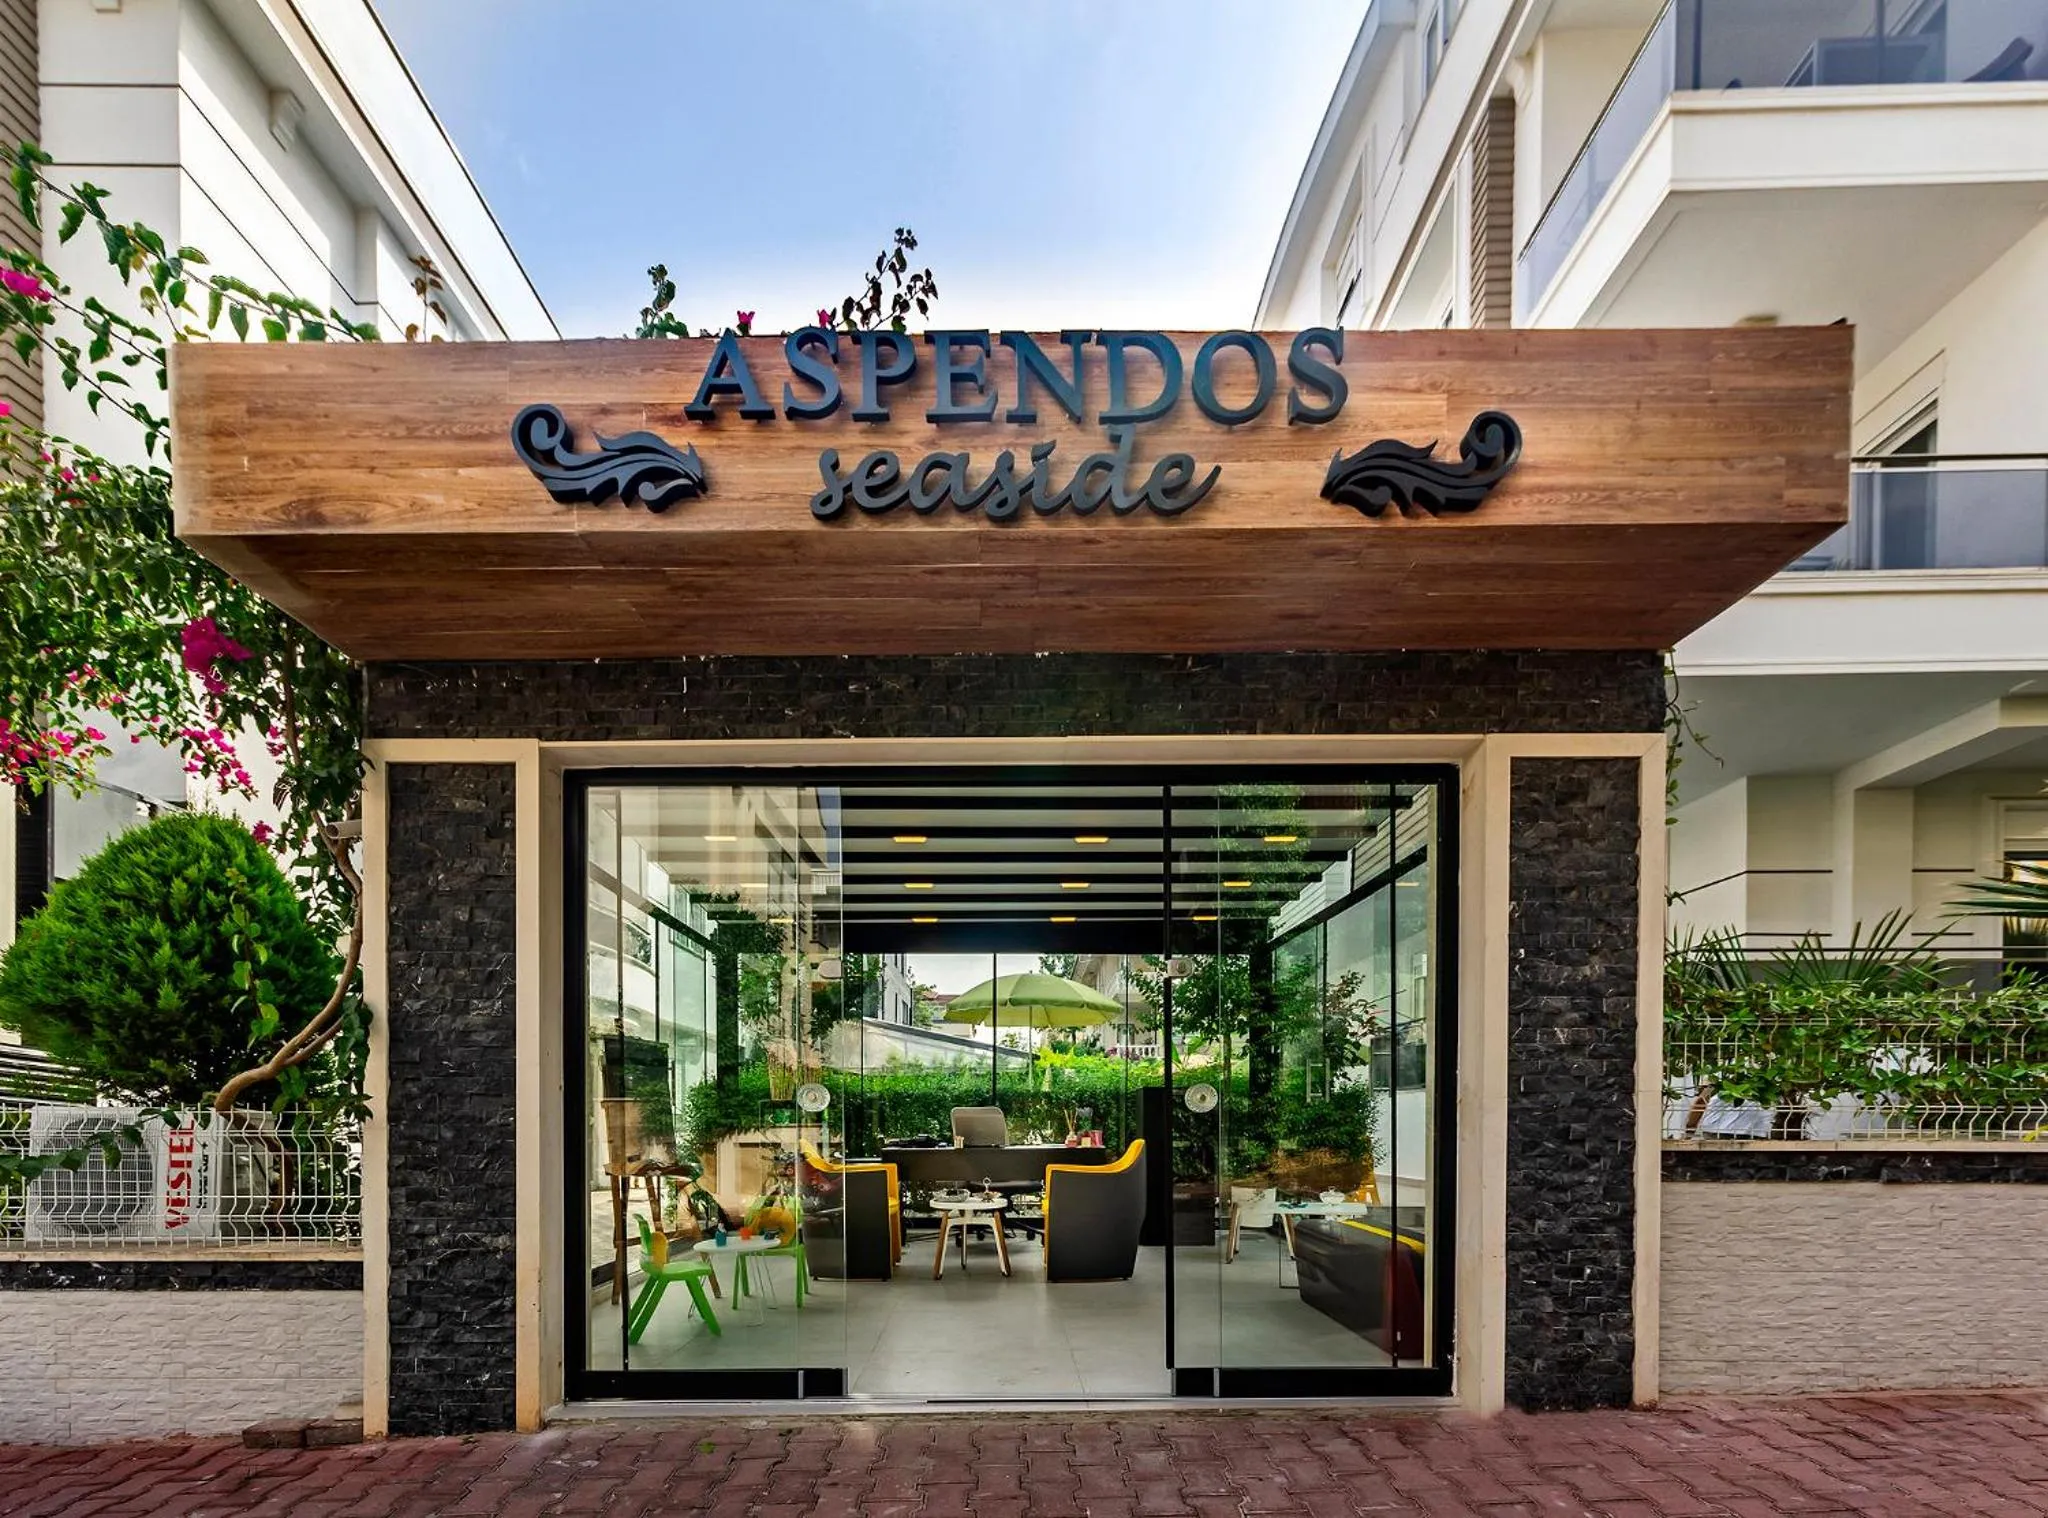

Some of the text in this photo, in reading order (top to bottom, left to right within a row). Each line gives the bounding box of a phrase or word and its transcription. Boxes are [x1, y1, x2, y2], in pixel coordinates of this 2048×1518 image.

[684, 326, 1348, 425] ASPENDOS
[810, 424, 1221, 521] seaside
[165, 1119, 195, 1230] VESTEL
